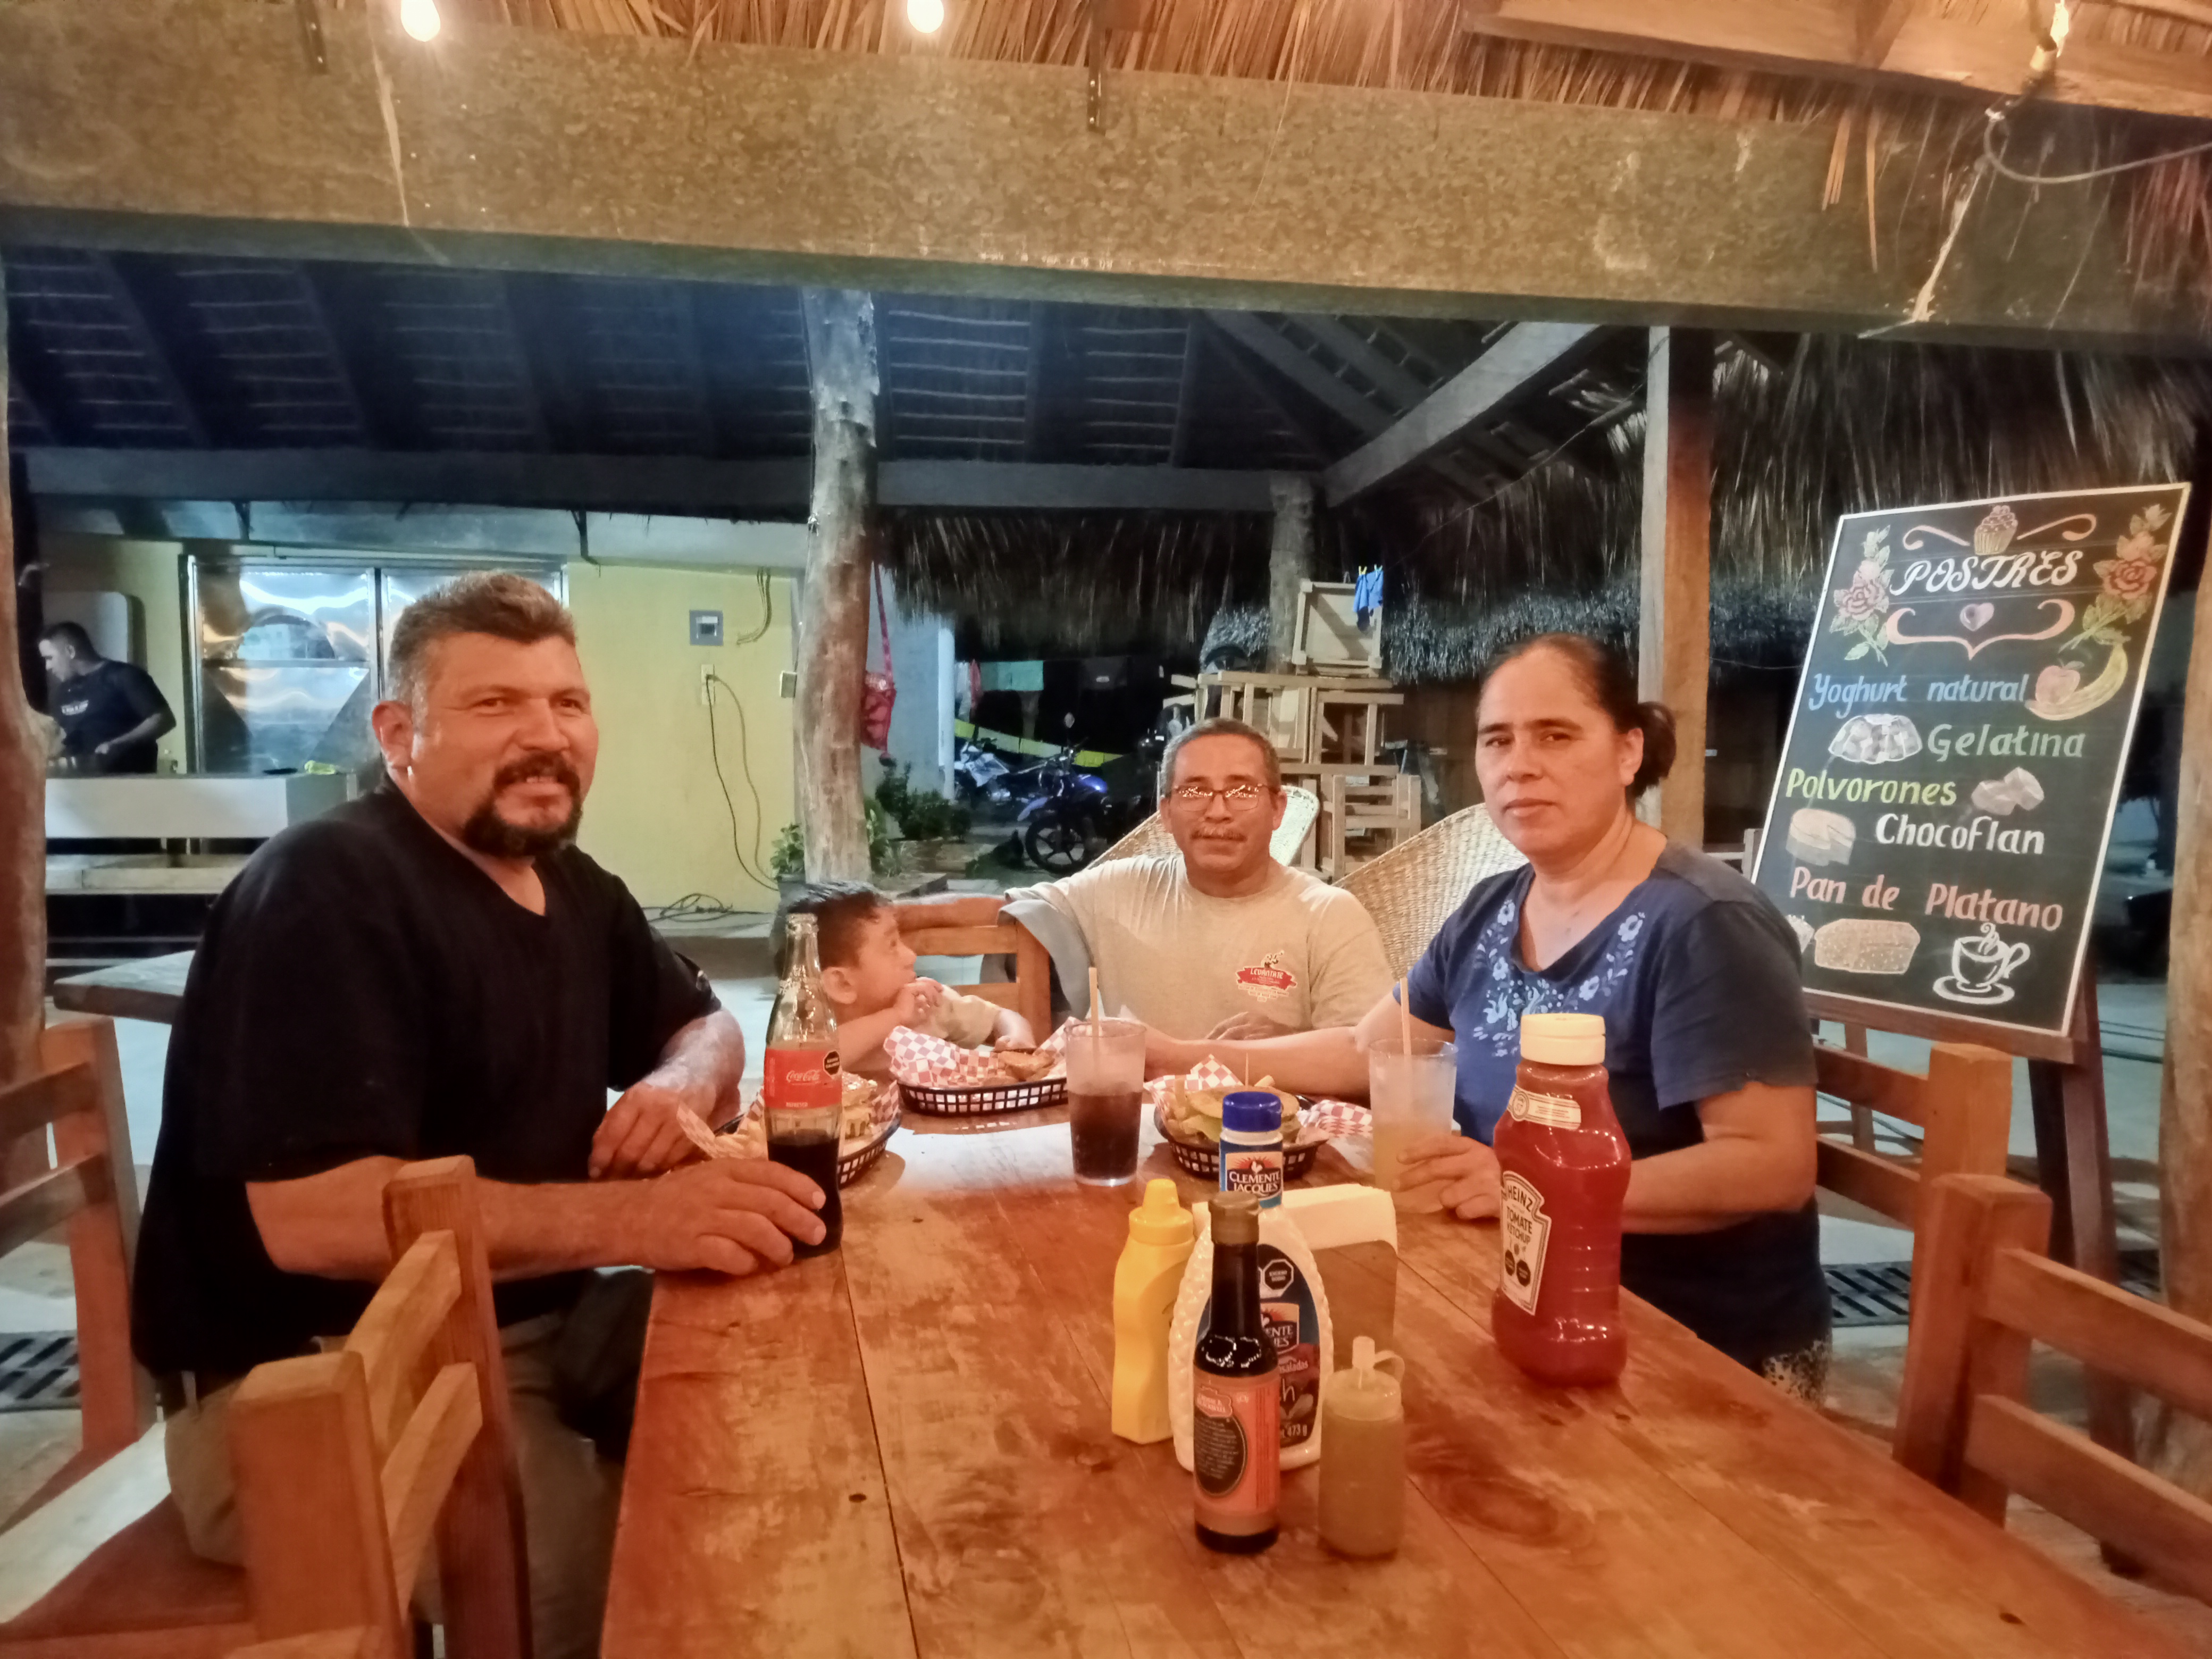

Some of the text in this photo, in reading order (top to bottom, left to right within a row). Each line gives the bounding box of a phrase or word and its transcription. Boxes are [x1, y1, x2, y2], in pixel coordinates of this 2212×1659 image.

[1890, 551, 2083, 596] POSTRES
[1808, 673, 2030, 719] Yoghurt natural
[1928, 724, 2086, 762] Gelatina
[1786, 767, 1957, 806] Polvorones
[1790, 867, 2064, 932] Pan de Platano
[1229, 1171, 1280, 1184] CLEMENTE
[1234, 1183, 1278, 1196] JACQUES
[1508, 1185, 1533, 1212] HEINZ
[1506, 1206, 1532, 1235] TOMATE
[1507, 1224, 1531, 1245] KETCHUP
